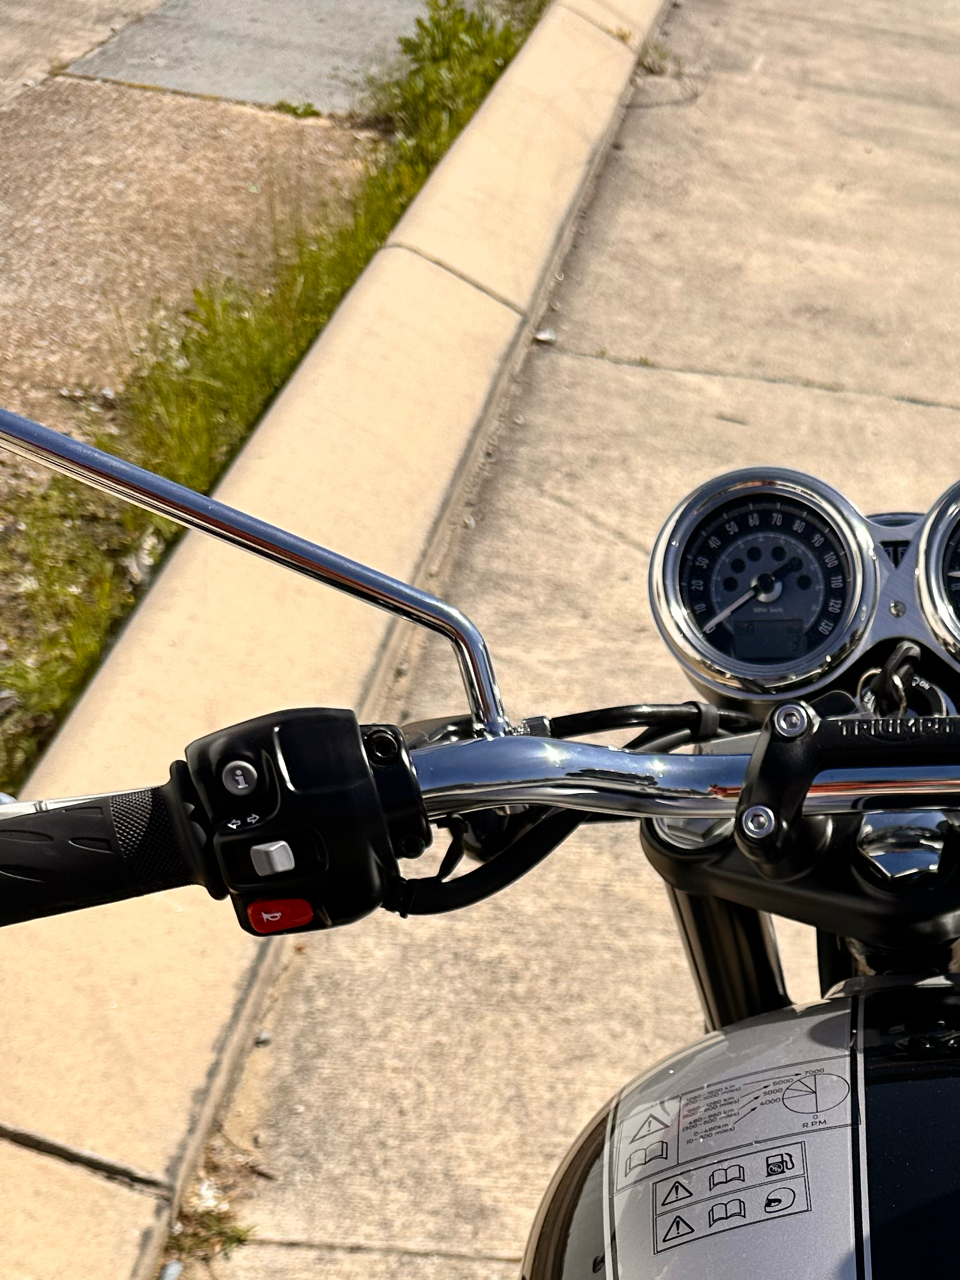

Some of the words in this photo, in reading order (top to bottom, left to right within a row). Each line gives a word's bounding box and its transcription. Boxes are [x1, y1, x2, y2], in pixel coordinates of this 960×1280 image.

[748, 513, 760, 527] 60
[771, 513, 783, 527] 70
[792, 519, 806, 534] 80
[725, 521, 739, 535] 50
[707, 536, 722, 549] 40
[811, 533, 825, 548] 90
[695, 556, 709, 569] 30
[823, 551, 839, 568] 100
[691, 580, 704, 591] 20
[830, 575, 844, 589] 110
[694, 603, 707, 614] 10
[828, 599, 842, 614] 120
[817, 620, 835, 636] 130
[918, 680, 931, 691] ON
[838, 718, 955, 737] TRIUMPH
[804, 1068, 825, 1076] 7000
[772, 1078, 794, 1086] 6000
[720, 1086, 742, 1096] miles)
[763, 1088, 783, 1096] 5000
[719, 1098, 740, 1108] miles)
[760, 1097, 781, 1106] 4000
[718, 1111, 740, 1120] miles)
[714, 1125, 736, 1135] miles)
